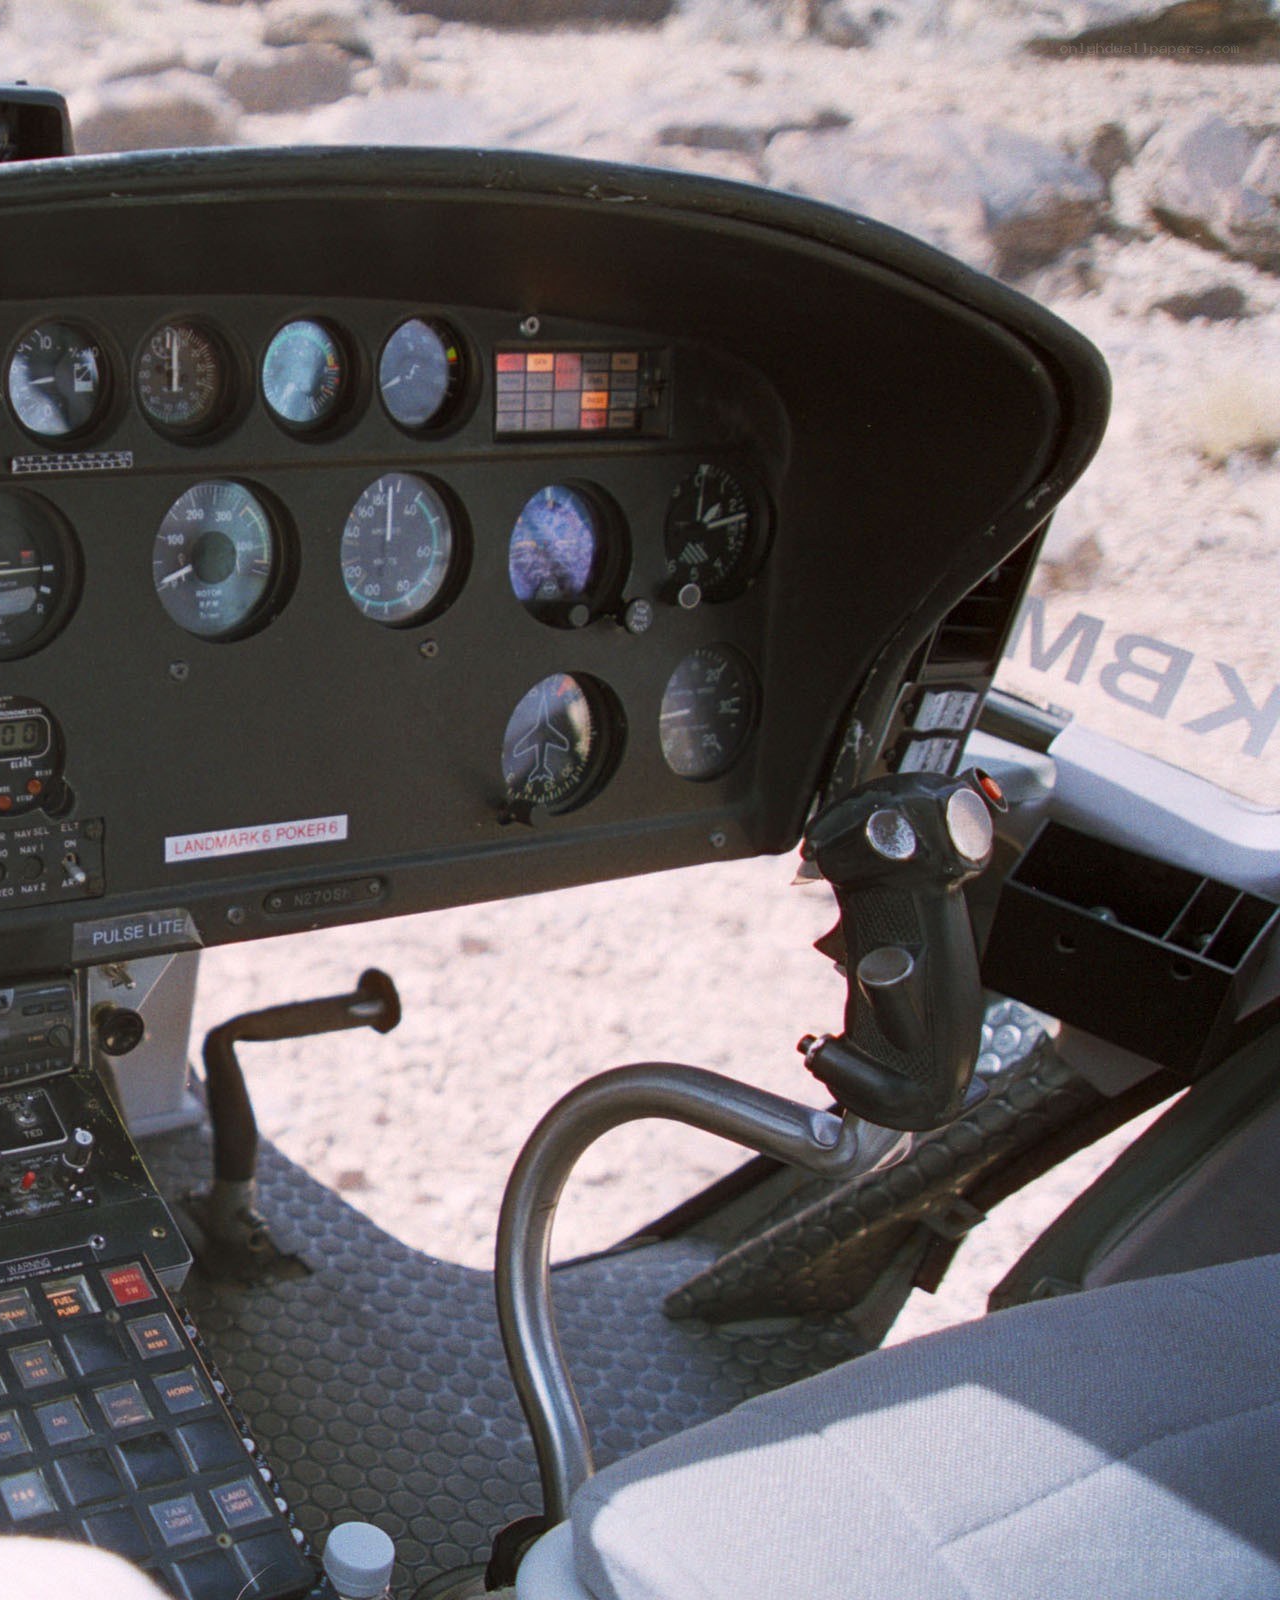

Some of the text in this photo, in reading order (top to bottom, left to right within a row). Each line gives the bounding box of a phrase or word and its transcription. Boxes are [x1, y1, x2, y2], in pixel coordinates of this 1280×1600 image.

[186, 508, 204, 520] 200
[358, 506, 374, 518] 160
[403, 503, 417, 515] 40
[215, 510, 232, 522] 300
[167, 533, 184, 545] 100
[417, 545, 431, 557] 60
[345, 566, 361, 577] 120
[364, 583, 381, 596] 100
[397, 580, 410, 591] 80
[37, 603, 44, 613] R
[10, 760, 33, 769] CLOCK
[14, 826, 50, 839] NAV SEL
[60, 822, 80, 833] ELT
[174, 820, 338, 855] LANDMARK 6 POKER 6
[20, 845, 38, 854] NAV
[64, 839, 77, 849] ON
[21, 882, 47, 894] NAV 2
[93, 918, 182, 946] PULSE LITE
[14, 1089, 44, 1100] SELCT
[23, 1128, 44, 1140] TIED
[6, 1257, 52, 1274] WARNING
[111, 1273, 141, 1286] MASTER
[125, 1286, 139, 1296] SW
[52, 1296, 76, 1307] FUEL
[56, 1305, 81, 1318] PUMP
[143, 1328, 160, 1339] GEN
[146, 1338, 168, 1350] RESET
[166, 1384, 194, 1398] HORN
[219, 1488, 248, 1502] LAND
[165, 1504, 185, 1517] TAXI
[225, 1498, 254, 1513] LIGHT
[166, 1514, 193, 1529] LIGHT
